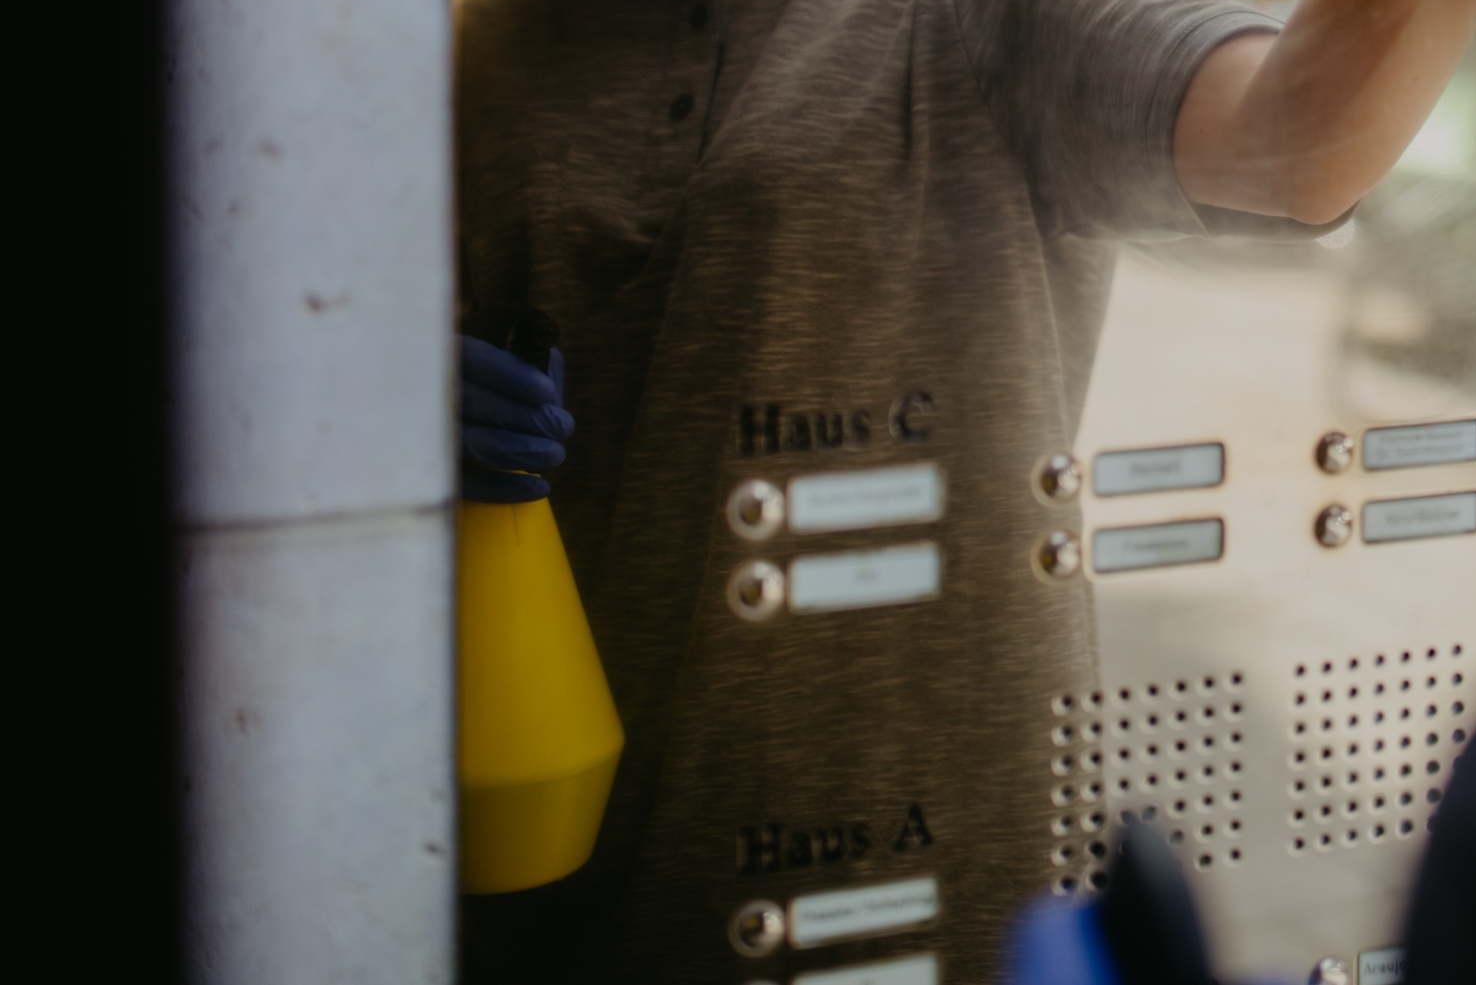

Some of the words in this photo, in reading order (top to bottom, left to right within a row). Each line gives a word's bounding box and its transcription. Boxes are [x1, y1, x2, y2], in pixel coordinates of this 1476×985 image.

[739, 402, 870, 454] Haus
[889, 390, 935, 443] C
[738, 820, 870, 874] Haus
[894, 801, 936, 852] A
